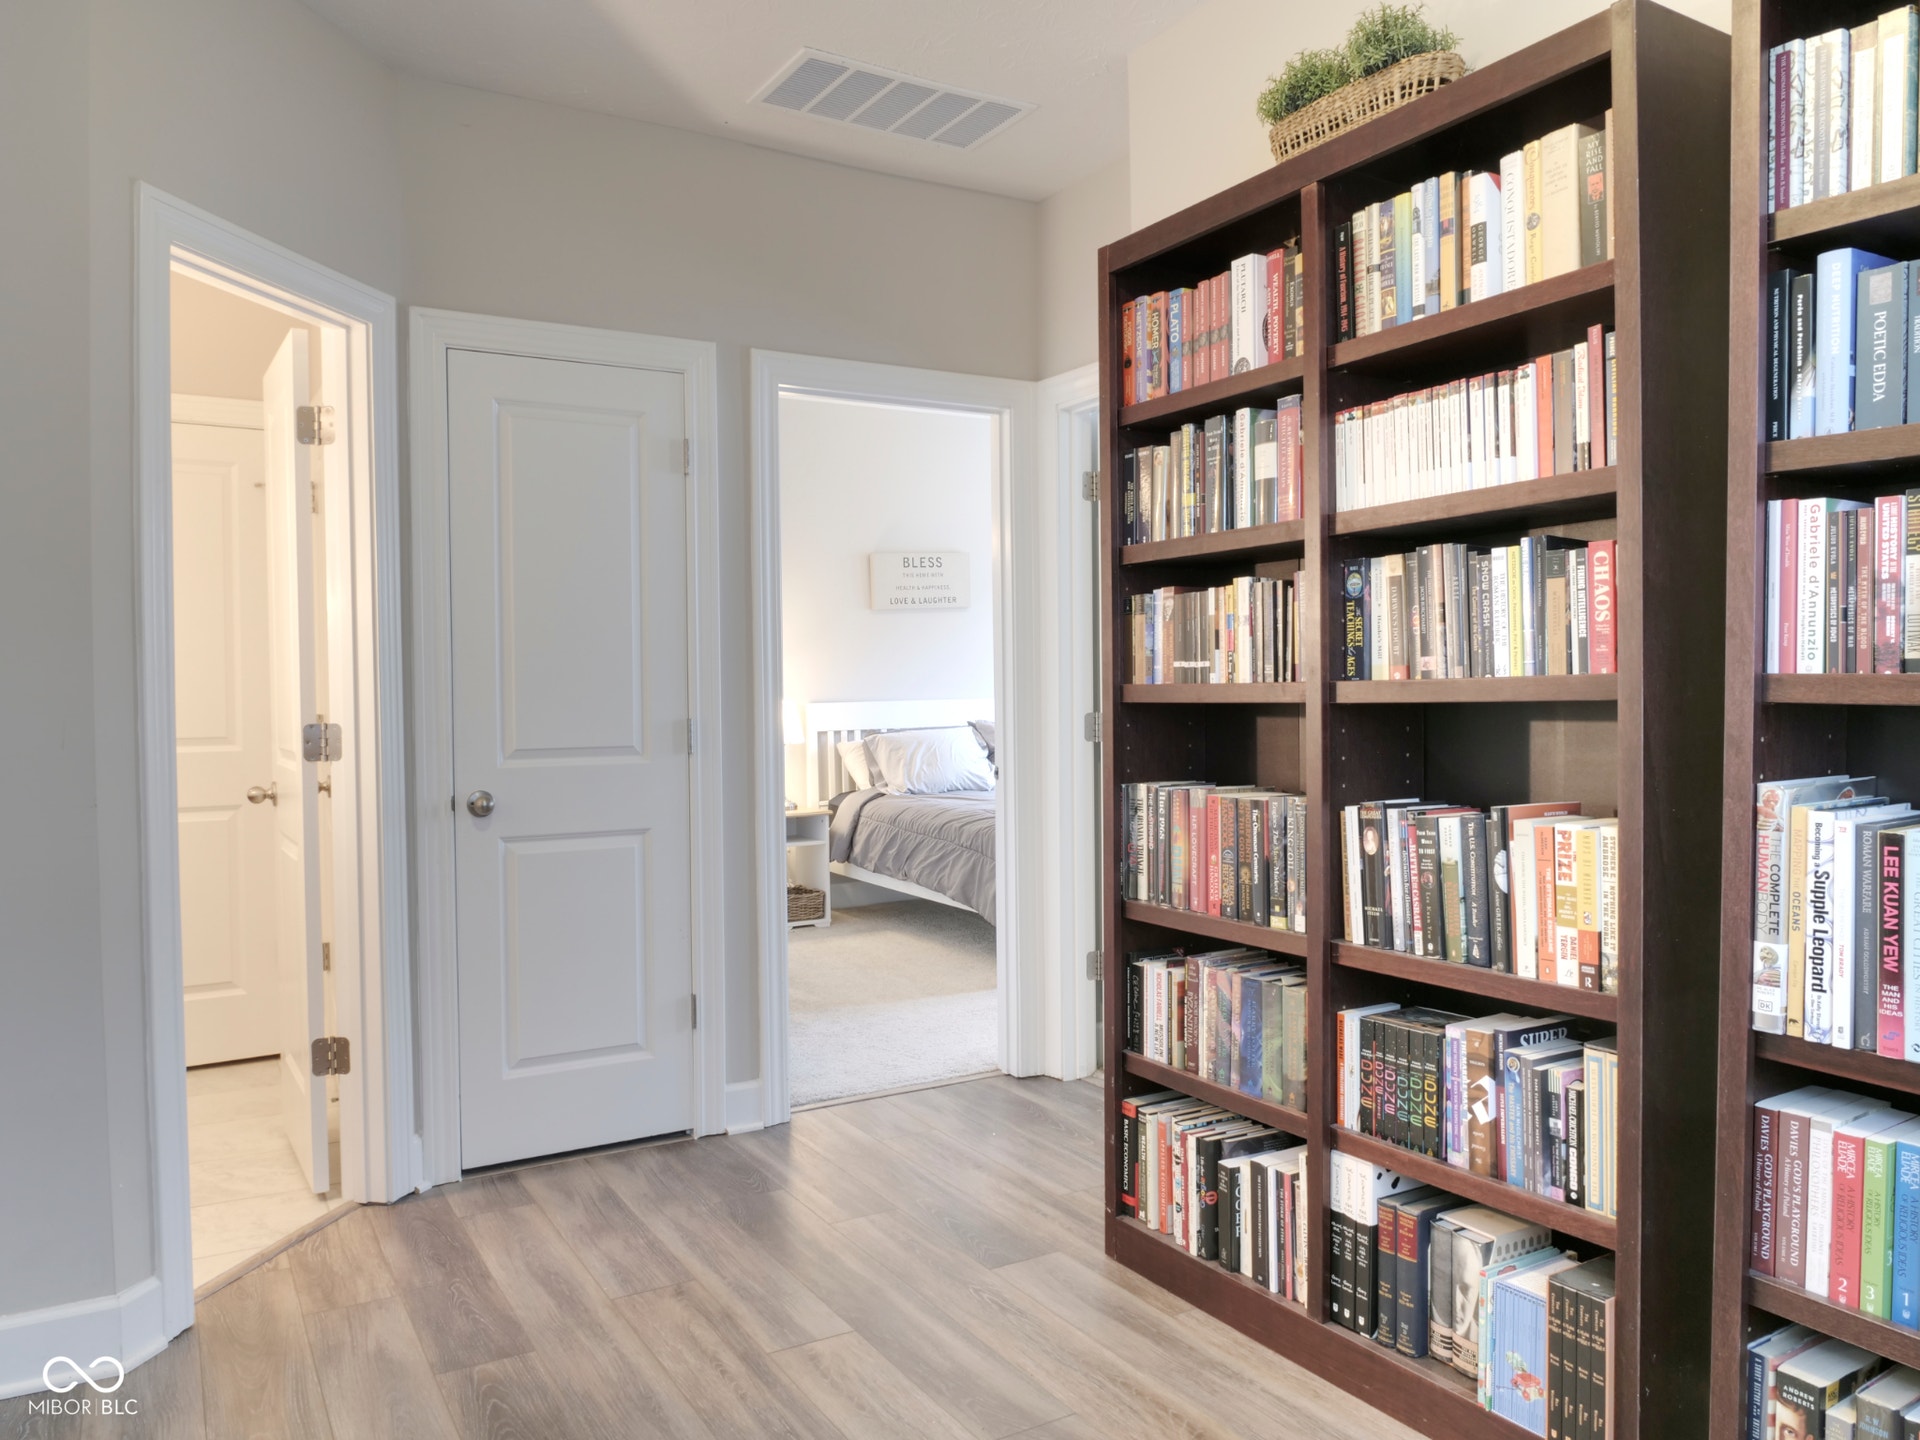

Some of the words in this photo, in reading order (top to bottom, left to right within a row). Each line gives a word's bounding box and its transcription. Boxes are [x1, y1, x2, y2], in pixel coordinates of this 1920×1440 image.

[1586, 146, 1603, 158] RISE
[1586, 155, 1603, 166] AND
[1587, 139, 1600, 150] MY
[1586, 163, 1603, 175] FALL
[1272, 273, 1280, 313] WEALTH,
[1830, 263, 1841, 290] DEEP
[1151, 312, 1159, 349] HOMER
[1170, 303, 1179, 343] PLATO
[1272, 316, 1280, 355] POVERTY
[1830, 295, 1841, 354] NUTRITION
[1873, 311, 1887, 360] POETIC
[1576, 348, 1586, 384] Radical
[1576, 386, 1586, 409] Islam
[1873, 365, 1887, 402] EDDA
[1808, 505, 1821, 568] Gabriele
[1881, 503, 1890, 540] UNITED
[902, 556, 943, 569] BLESS
[1480, 560, 1490, 590] SNOW
[1577, 564, 1587, 589] FIXING
[1881, 542, 1890, 580] STATES
[889, 597, 908, 605] LOVE
[918, 596, 957, 604] LAUGHTER
[1593, 551, 1611, 622] CHAOS
[1346, 600, 1355, 647] TEACHINGS
[1391, 586, 1400, 627] DARWIN'S
[1480, 592, 1490, 627] CRASH
[1577, 590, 1587, 638] INTELLIGENCE
[1808, 576, 1821, 661] d'Annunzio
[1391, 627, 1400, 656] DOUBT
[1500, 622, 1507, 630] OF
[1848, 627, 1854, 635] OF
[1346, 655, 1355, 676] AGES
[1239, 802, 1245, 814] OF
[1556, 829, 1573, 882] PRIZE
[1602, 836, 1610, 878] AMBROSE
[1769, 838, 1781, 860] THE
[1812, 823, 1824, 860] Becoming
[1863, 831, 1872, 867] ROMAN
[1883, 846, 1899, 877] LEE
[1221, 864, 1229, 906] BEFORE
[1603, 891, 1609, 899] IN
[1769, 863, 1781, 936] COMPLETE
[1809, 870, 1829, 924] Supple
[1863, 869, 1872, 913] WARFARE
[1609, 885, 1617, 921] NOTHING
[1883, 882, 1899, 930] KUAN
[1560, 934, 1568, 960] YERGIN
[1569, 937, 1578, 961] DANIEL
[1609, 922, 1617, 942] LIKE
[1609, 943, 1617, 952] IT
[1809, 929, 1829, 994] Leopard
[1883, 934, 1899, 973] YEW
[1156, 972, 1164, 998] NICHOLAS
[1584, 976, 1592, 988] R
[1882, 990, 1900, 998] MAN
[1156, 998, 1164, 1021] FARRELL
[1759, 1002, 1771, 1010] DK
[1879, 1008, 1902, 1017] IDEAS
[1361, 1058, 1373, 1109] DUNE
[1375, 1061, 1384, 1095] DUNE
[1384, 1068, 1396, 1115] DUNE
[1397, 1076, 1408, 1122] DUNE
[1410, 1077, 1422, 1127] DUNE
[1424, 1080, 1437, 1129] DUNE
[1568, 1089, 1578, 1116] MICHAEL
[1760, 1115, 1771, 1151] DAVIES
[1789, 1120, 1799, 1157] DAVIES
[1569, 1147, 1578, 1190] CONGO
[1763, 1153, 1774, 1187] GOD'S
[1837, 1140, 1848, 1173] ELIADE
[1847, 1143, 1857, 1179] MIRCEA
[1867, 1146, 1875, 1173] ELIADE
[1873, 1149, 1883, 1178] MIRCEA
[1900, 1151, 1911, 1184] ELIADE
[1910, 1154, 1920, 1190] MIRCEA
[1793, 1160, 1803, 1193] GOD'S
[1910, 1196, 1919, 1204] A
[1760, 1188, 1773, 1260] PLAYGROUND
[1789, 1194, 1801, 1267] PLAYGROUND
[1910, 1205, 1919, 1244] HISTORY
[1838, 1278, 1847, 1292] 2
[1865, 1286, 1875, 1300] 3
[1902, 1292, 1909, 1307] 1
[1782, 1392, 1816, 1411] ROBERTS
[1783, 1384, 1815, 1401] ANDREW
[1859, 1423, 1890, 1438] JOHNSON
